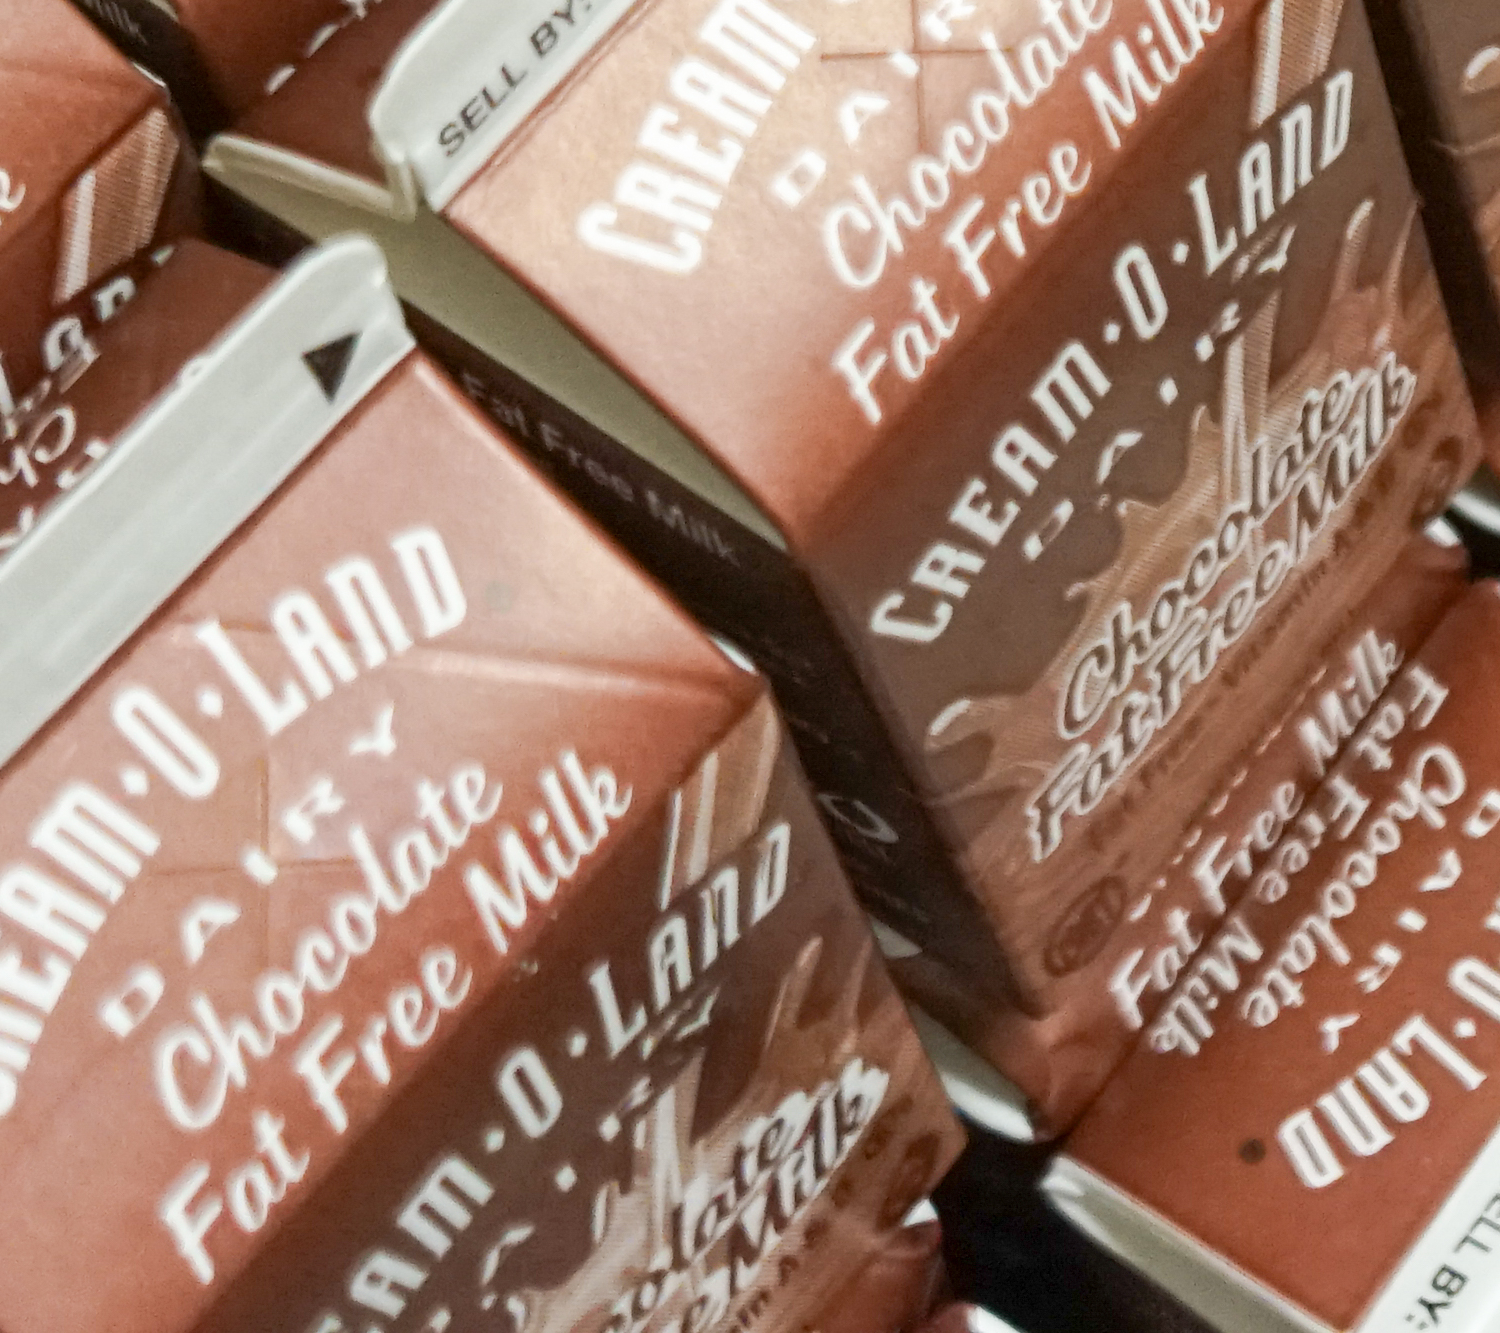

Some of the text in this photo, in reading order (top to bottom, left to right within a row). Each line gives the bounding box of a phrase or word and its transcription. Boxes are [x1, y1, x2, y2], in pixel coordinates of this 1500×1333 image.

[438, 63, 525, 158] SELL
[832, 281, 958, 425] Fat
[947, 154, 1092, 302] Free
[646, 488, 741, 567] Milk
[1058, 367, 1356, 744] Chocolate
[1027, 701, 1158, 864] Fat
[1148, 664, 1451, 1057] Fat Milk
[1241, 743, 1469, 1028] Chocolate
[152, 759, 502, 1134] Chocolate
[157, 749, 635, 1287] Fat Free Milk
[1405, 1260, 1469, 1331] BY:
